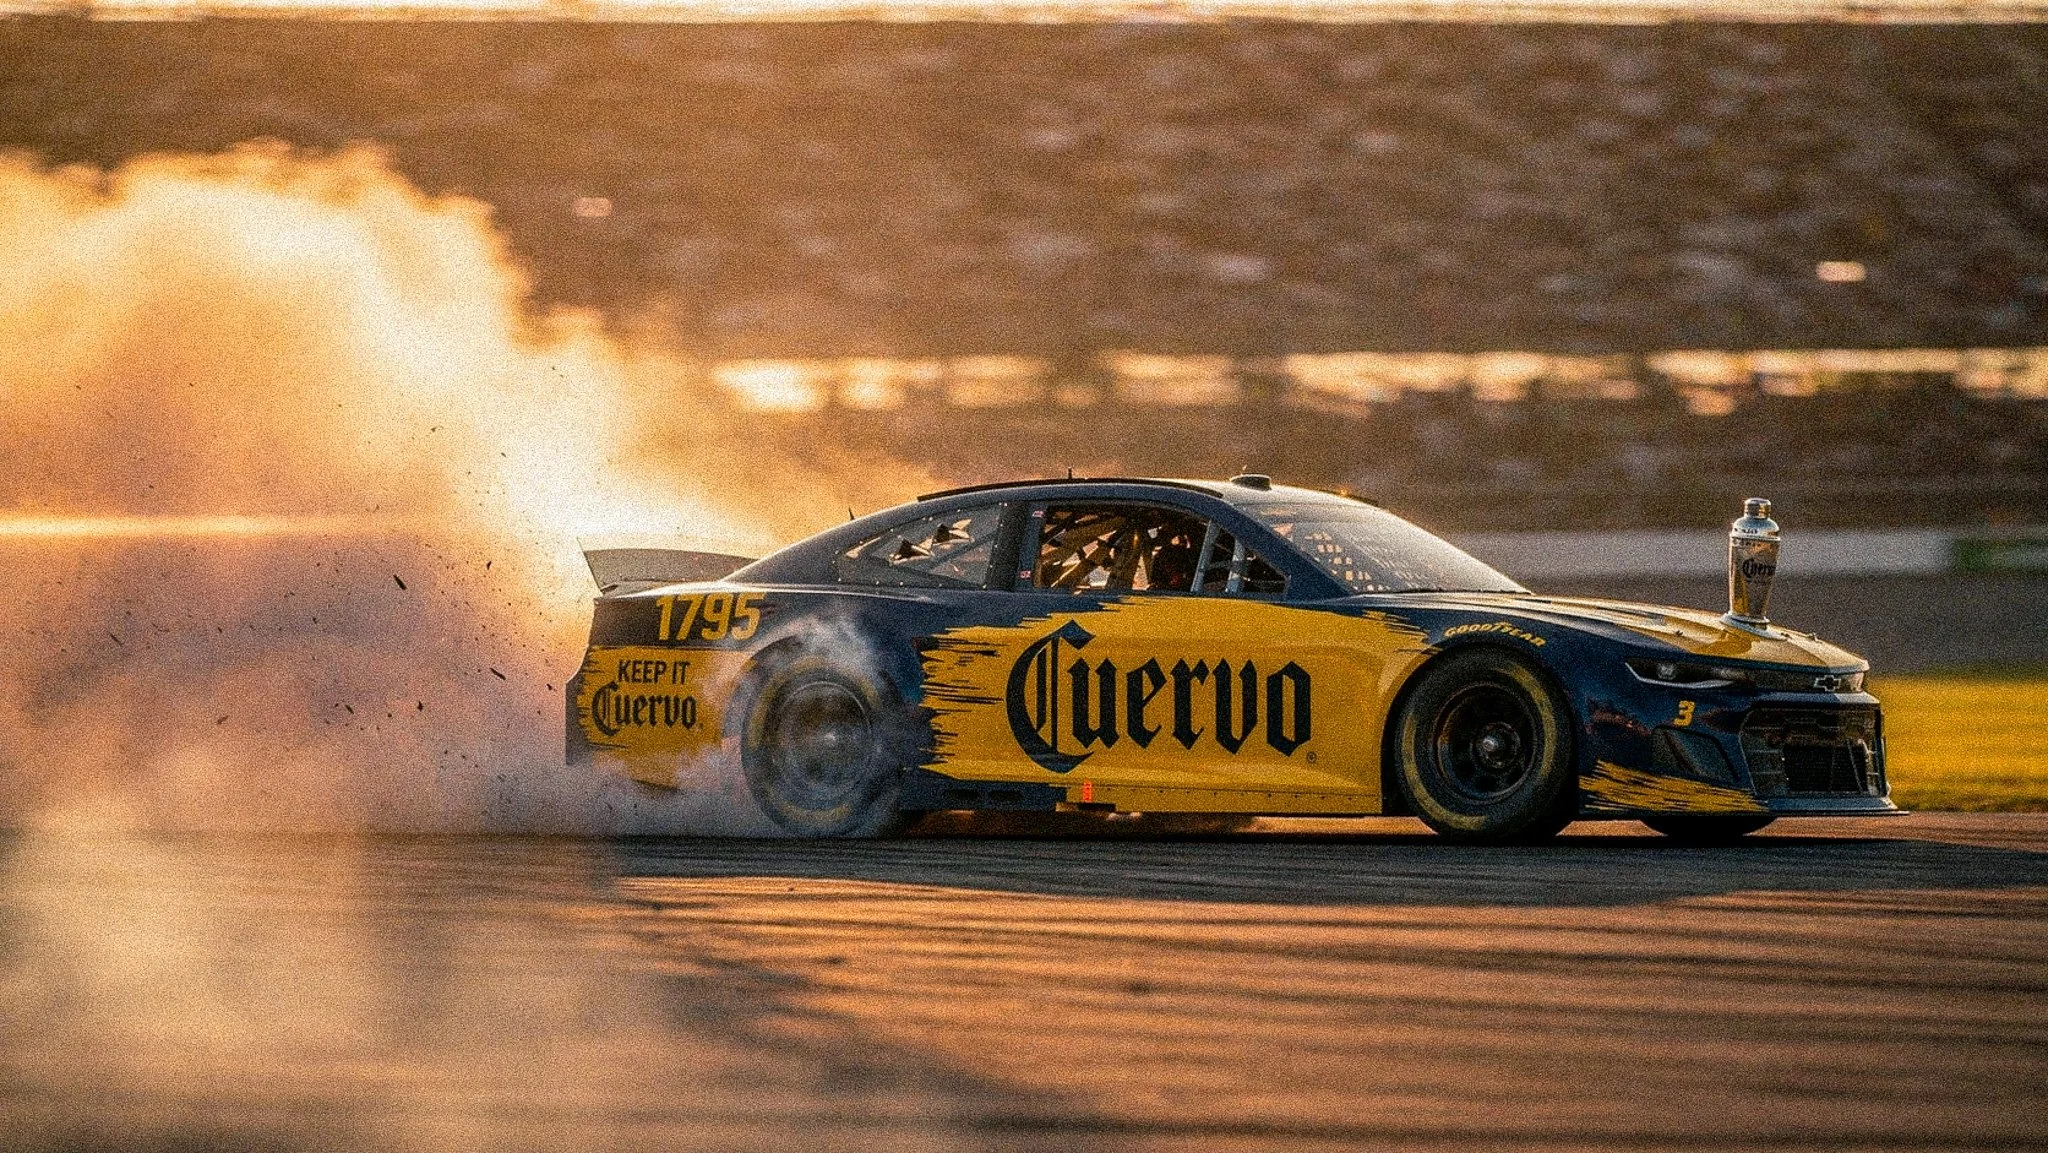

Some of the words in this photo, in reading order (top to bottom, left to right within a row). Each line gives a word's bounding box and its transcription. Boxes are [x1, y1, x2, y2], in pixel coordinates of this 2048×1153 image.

[656, 593, 765, 641] 1795
[1444, 620, 1547, 648] GOODYEAR
[618, 661, 666, 684] KEEP
[672, 662, 691, 685] IT
[592, 682, 697, 736] Cuervo
[1007, 620, 1311, 773] Cuervo
[1673, 700, 1695, 727] 3
